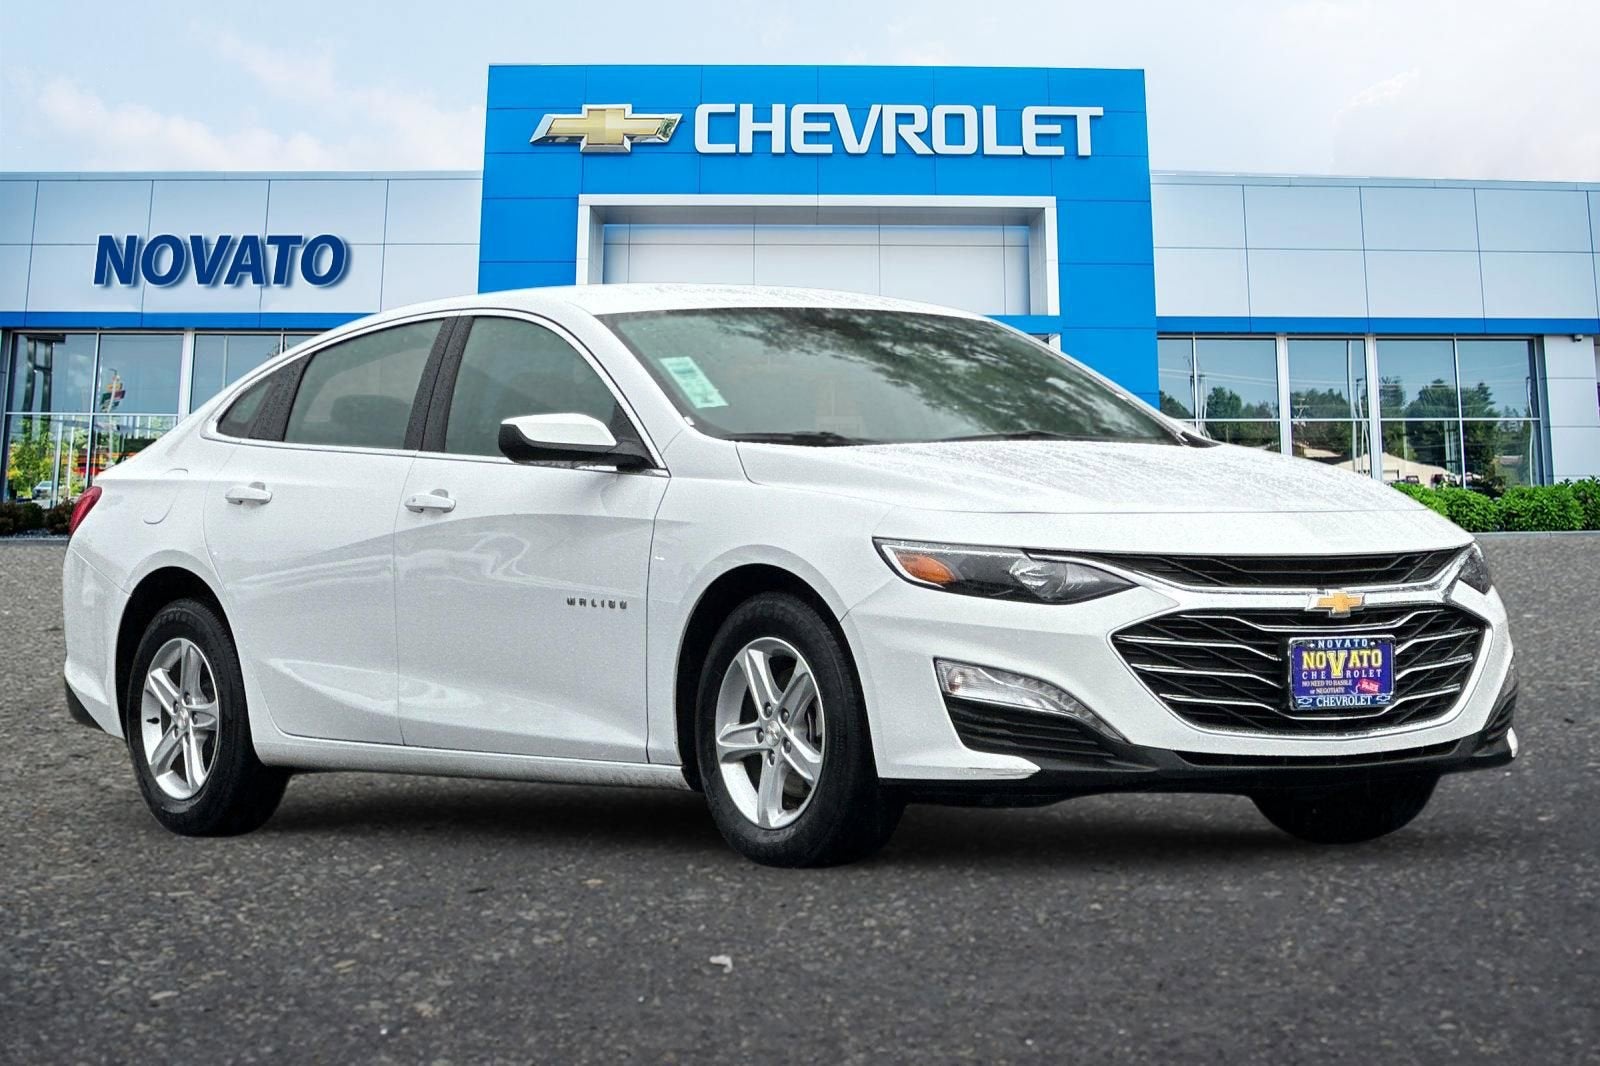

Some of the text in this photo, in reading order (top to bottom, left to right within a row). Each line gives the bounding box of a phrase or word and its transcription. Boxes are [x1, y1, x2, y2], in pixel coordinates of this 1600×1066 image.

[694, 103, 1104, 157] CHEVROLET
[94, 234, 347, 287] NOVATO
[566, 597, 628, 610] MALIBU
[1318, 639, 1368, 648] NOVATO
[1302, 649, 1382, 678] NOVATO
[1316, 696, 1372, 707] CHEVROLET
